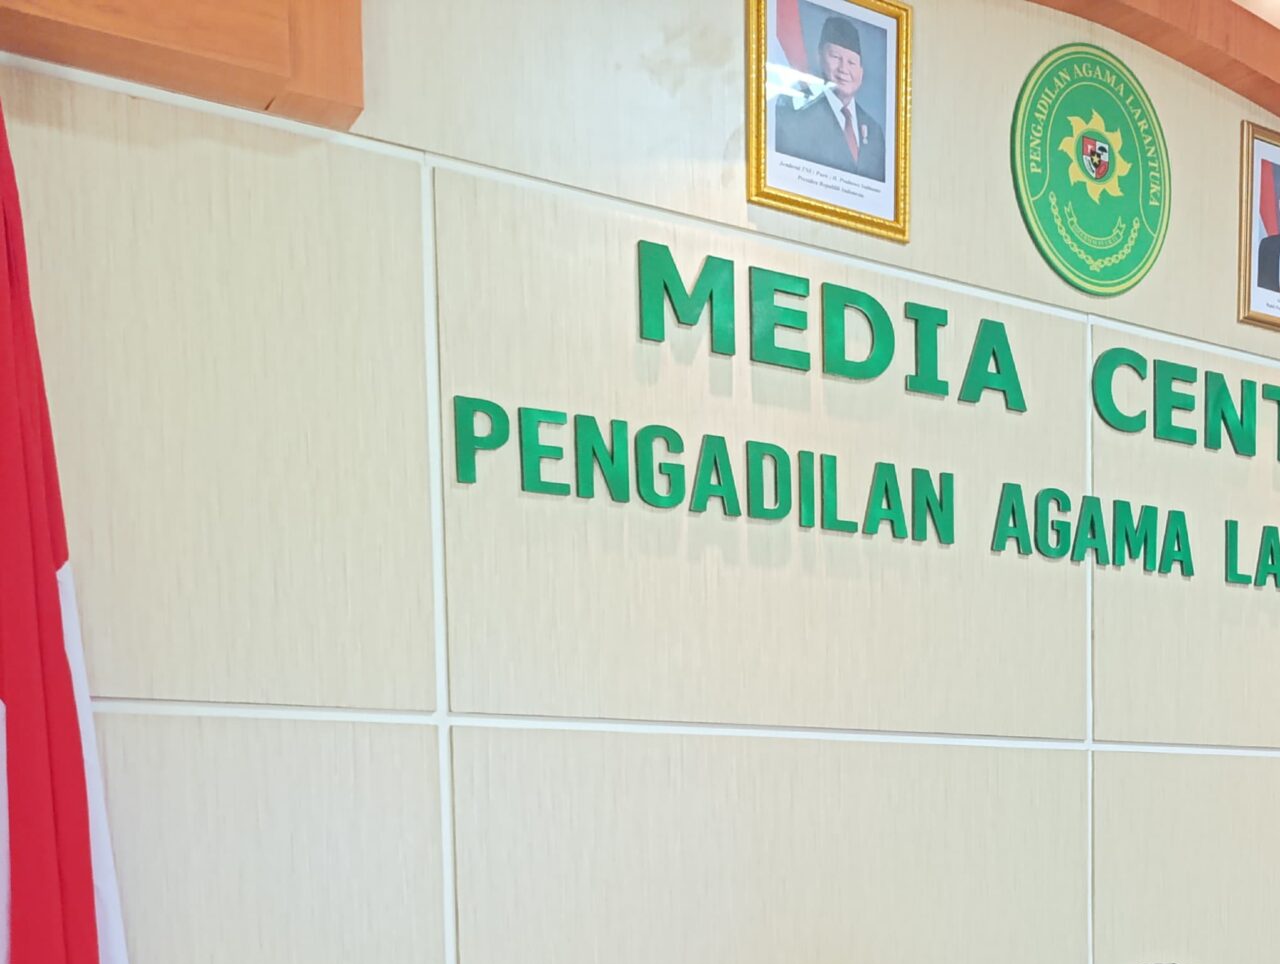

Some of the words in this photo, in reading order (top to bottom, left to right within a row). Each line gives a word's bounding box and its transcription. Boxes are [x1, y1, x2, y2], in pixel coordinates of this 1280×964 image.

[1030, 67, 1071, 174] PENGADILAN
[1073, 63, 1125, 97] AGAMA
[1125, 94, 1161, 207] LARANTUKA
[638, 239, 1027, 413] MEDIA
[453, 395, 955, 545] PENGADILAN
[990, 482, 1195, 577] AGAMA
